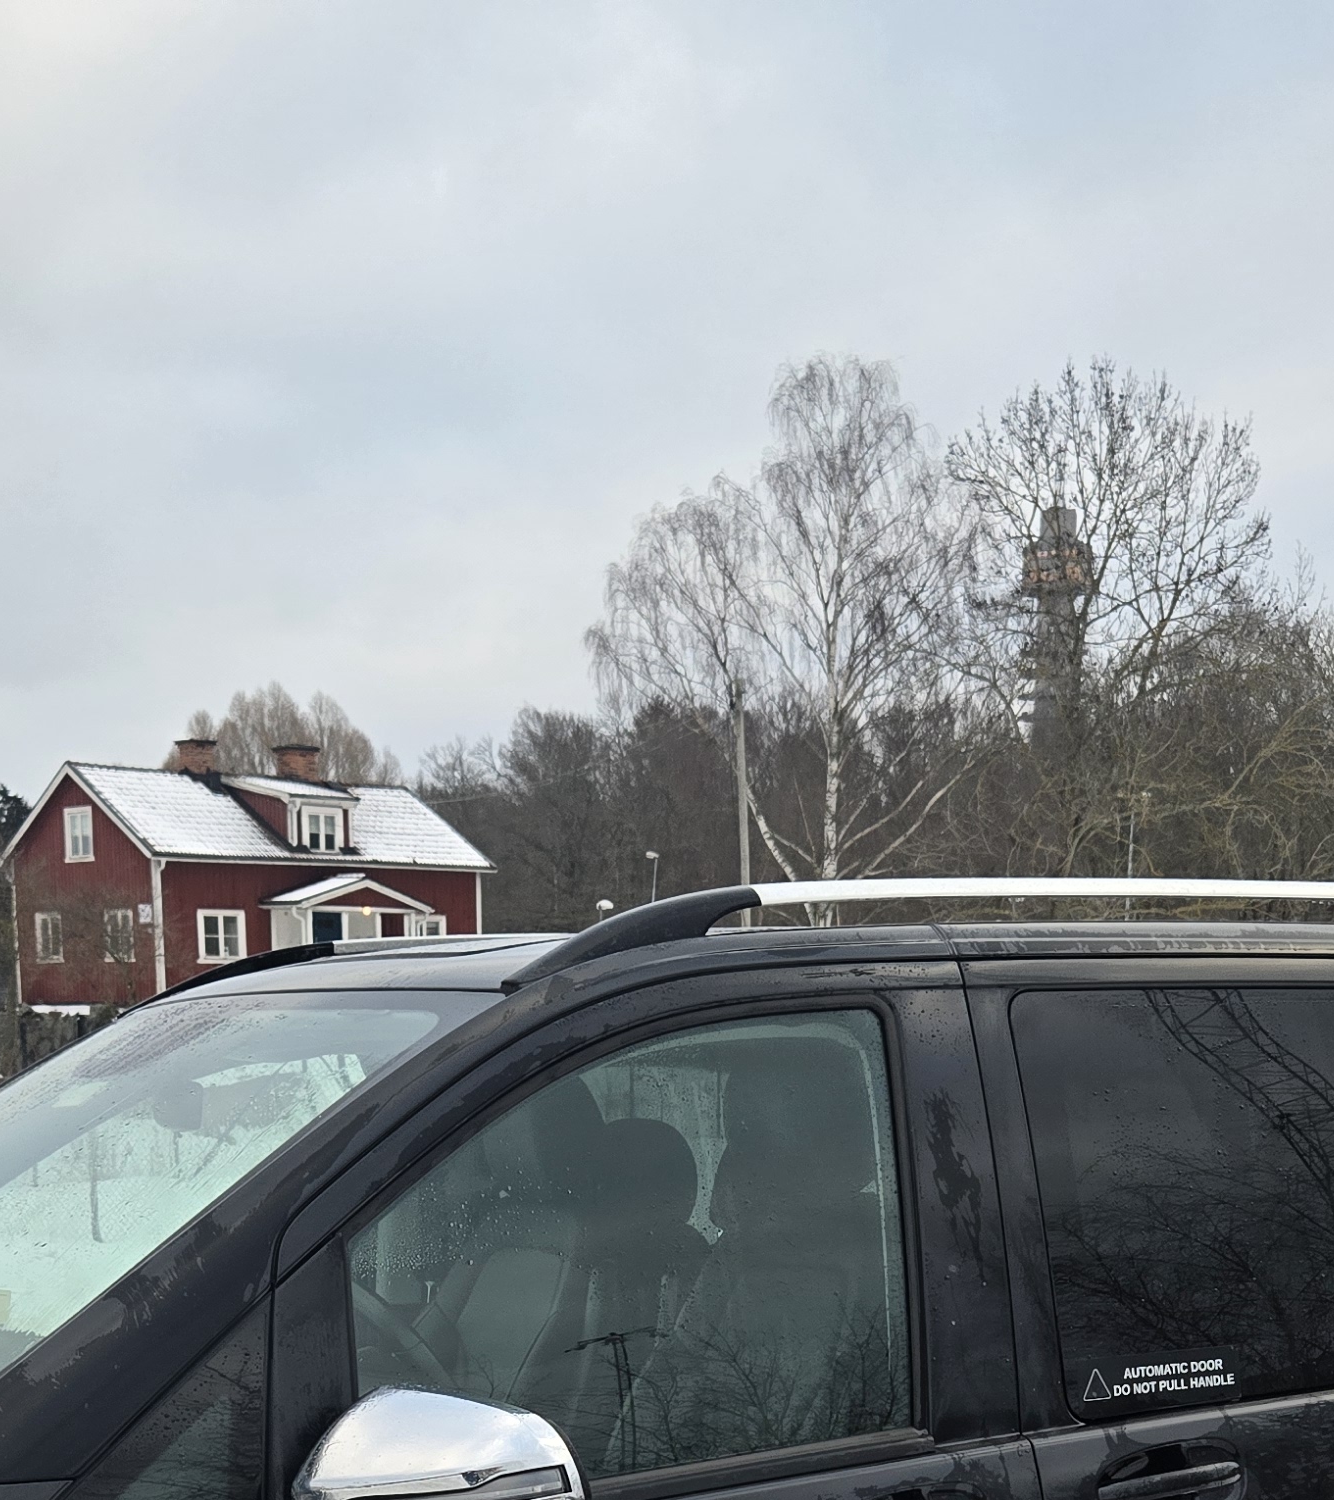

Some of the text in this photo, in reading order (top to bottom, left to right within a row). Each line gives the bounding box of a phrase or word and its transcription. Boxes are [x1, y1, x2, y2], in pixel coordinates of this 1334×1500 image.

[1124, 1358, 1223, 1379] AUTOMATIC DOOR
[1113, 1373, 1235, 1397] DO NOT PULL HANDLE
